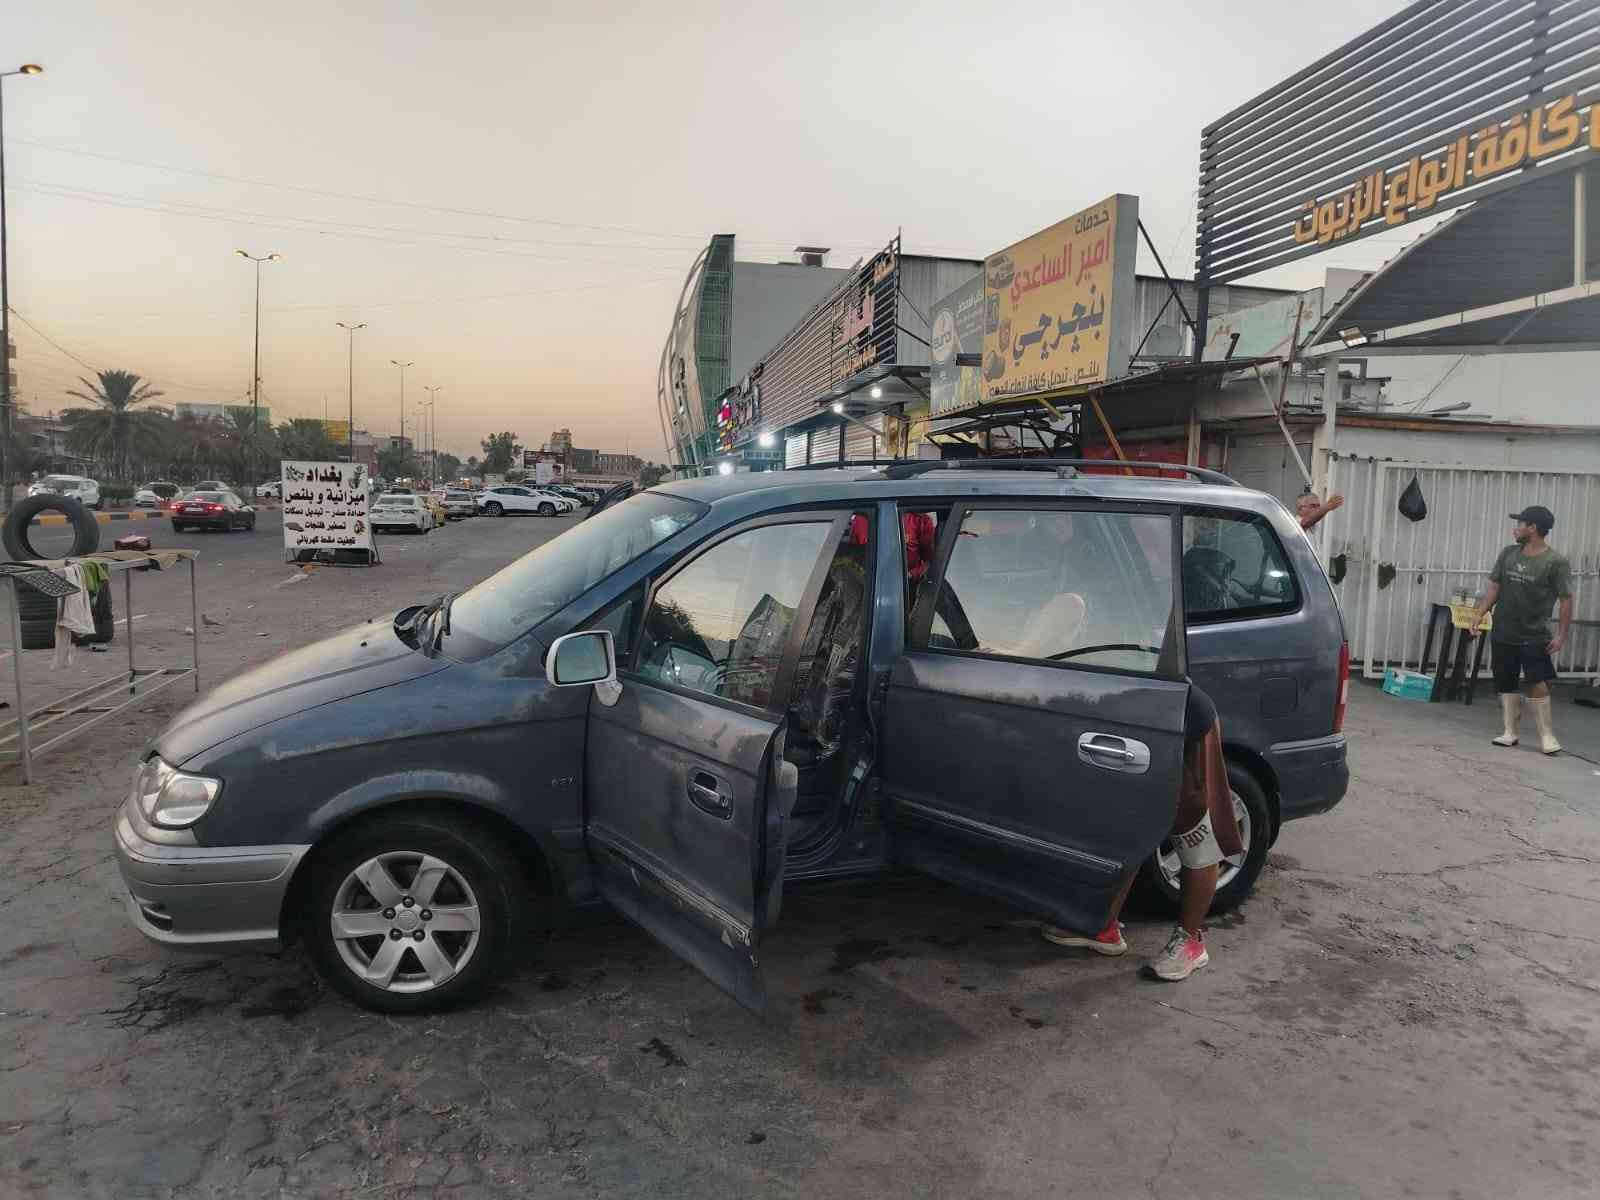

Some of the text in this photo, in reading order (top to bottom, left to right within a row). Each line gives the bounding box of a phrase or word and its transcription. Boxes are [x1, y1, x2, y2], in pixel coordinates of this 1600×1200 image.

[1472, 96, 1580, 177] كافة
[1075, 208, 1109, 234] خدمات
[1295, 168, 1386, 245] الزيوت
[1010, 240, 1073, 311] الساعدي
[1075, 224, 1112, 286] امير
[285, 488, 365, 505] ميزانية و بلنص
[306, 465, 343, 487] بغداد
[1182, 824, 1209, 849] HOP
